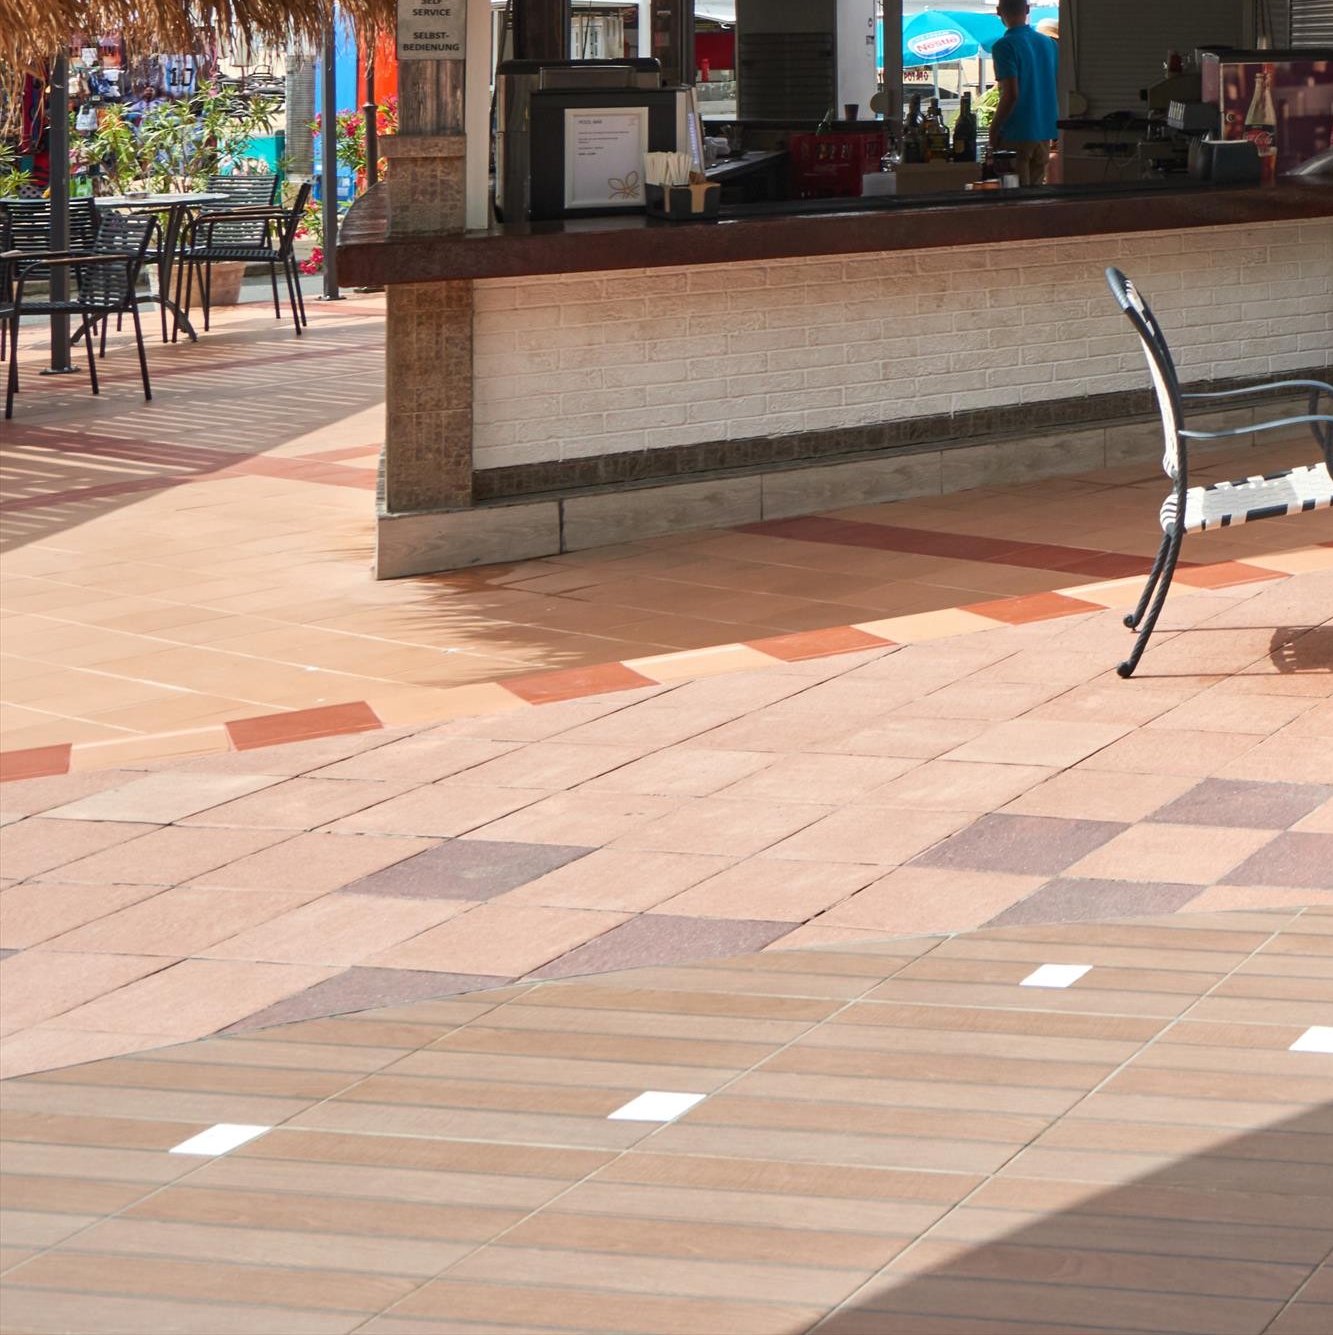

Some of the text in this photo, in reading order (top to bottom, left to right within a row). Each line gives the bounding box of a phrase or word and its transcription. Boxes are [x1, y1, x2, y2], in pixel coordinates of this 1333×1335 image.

[412, 8, 452, 17] SERVICE
[413, 32, 450, 40] SELBST-
[402, 43, 460, 51] BEDIENUNG
